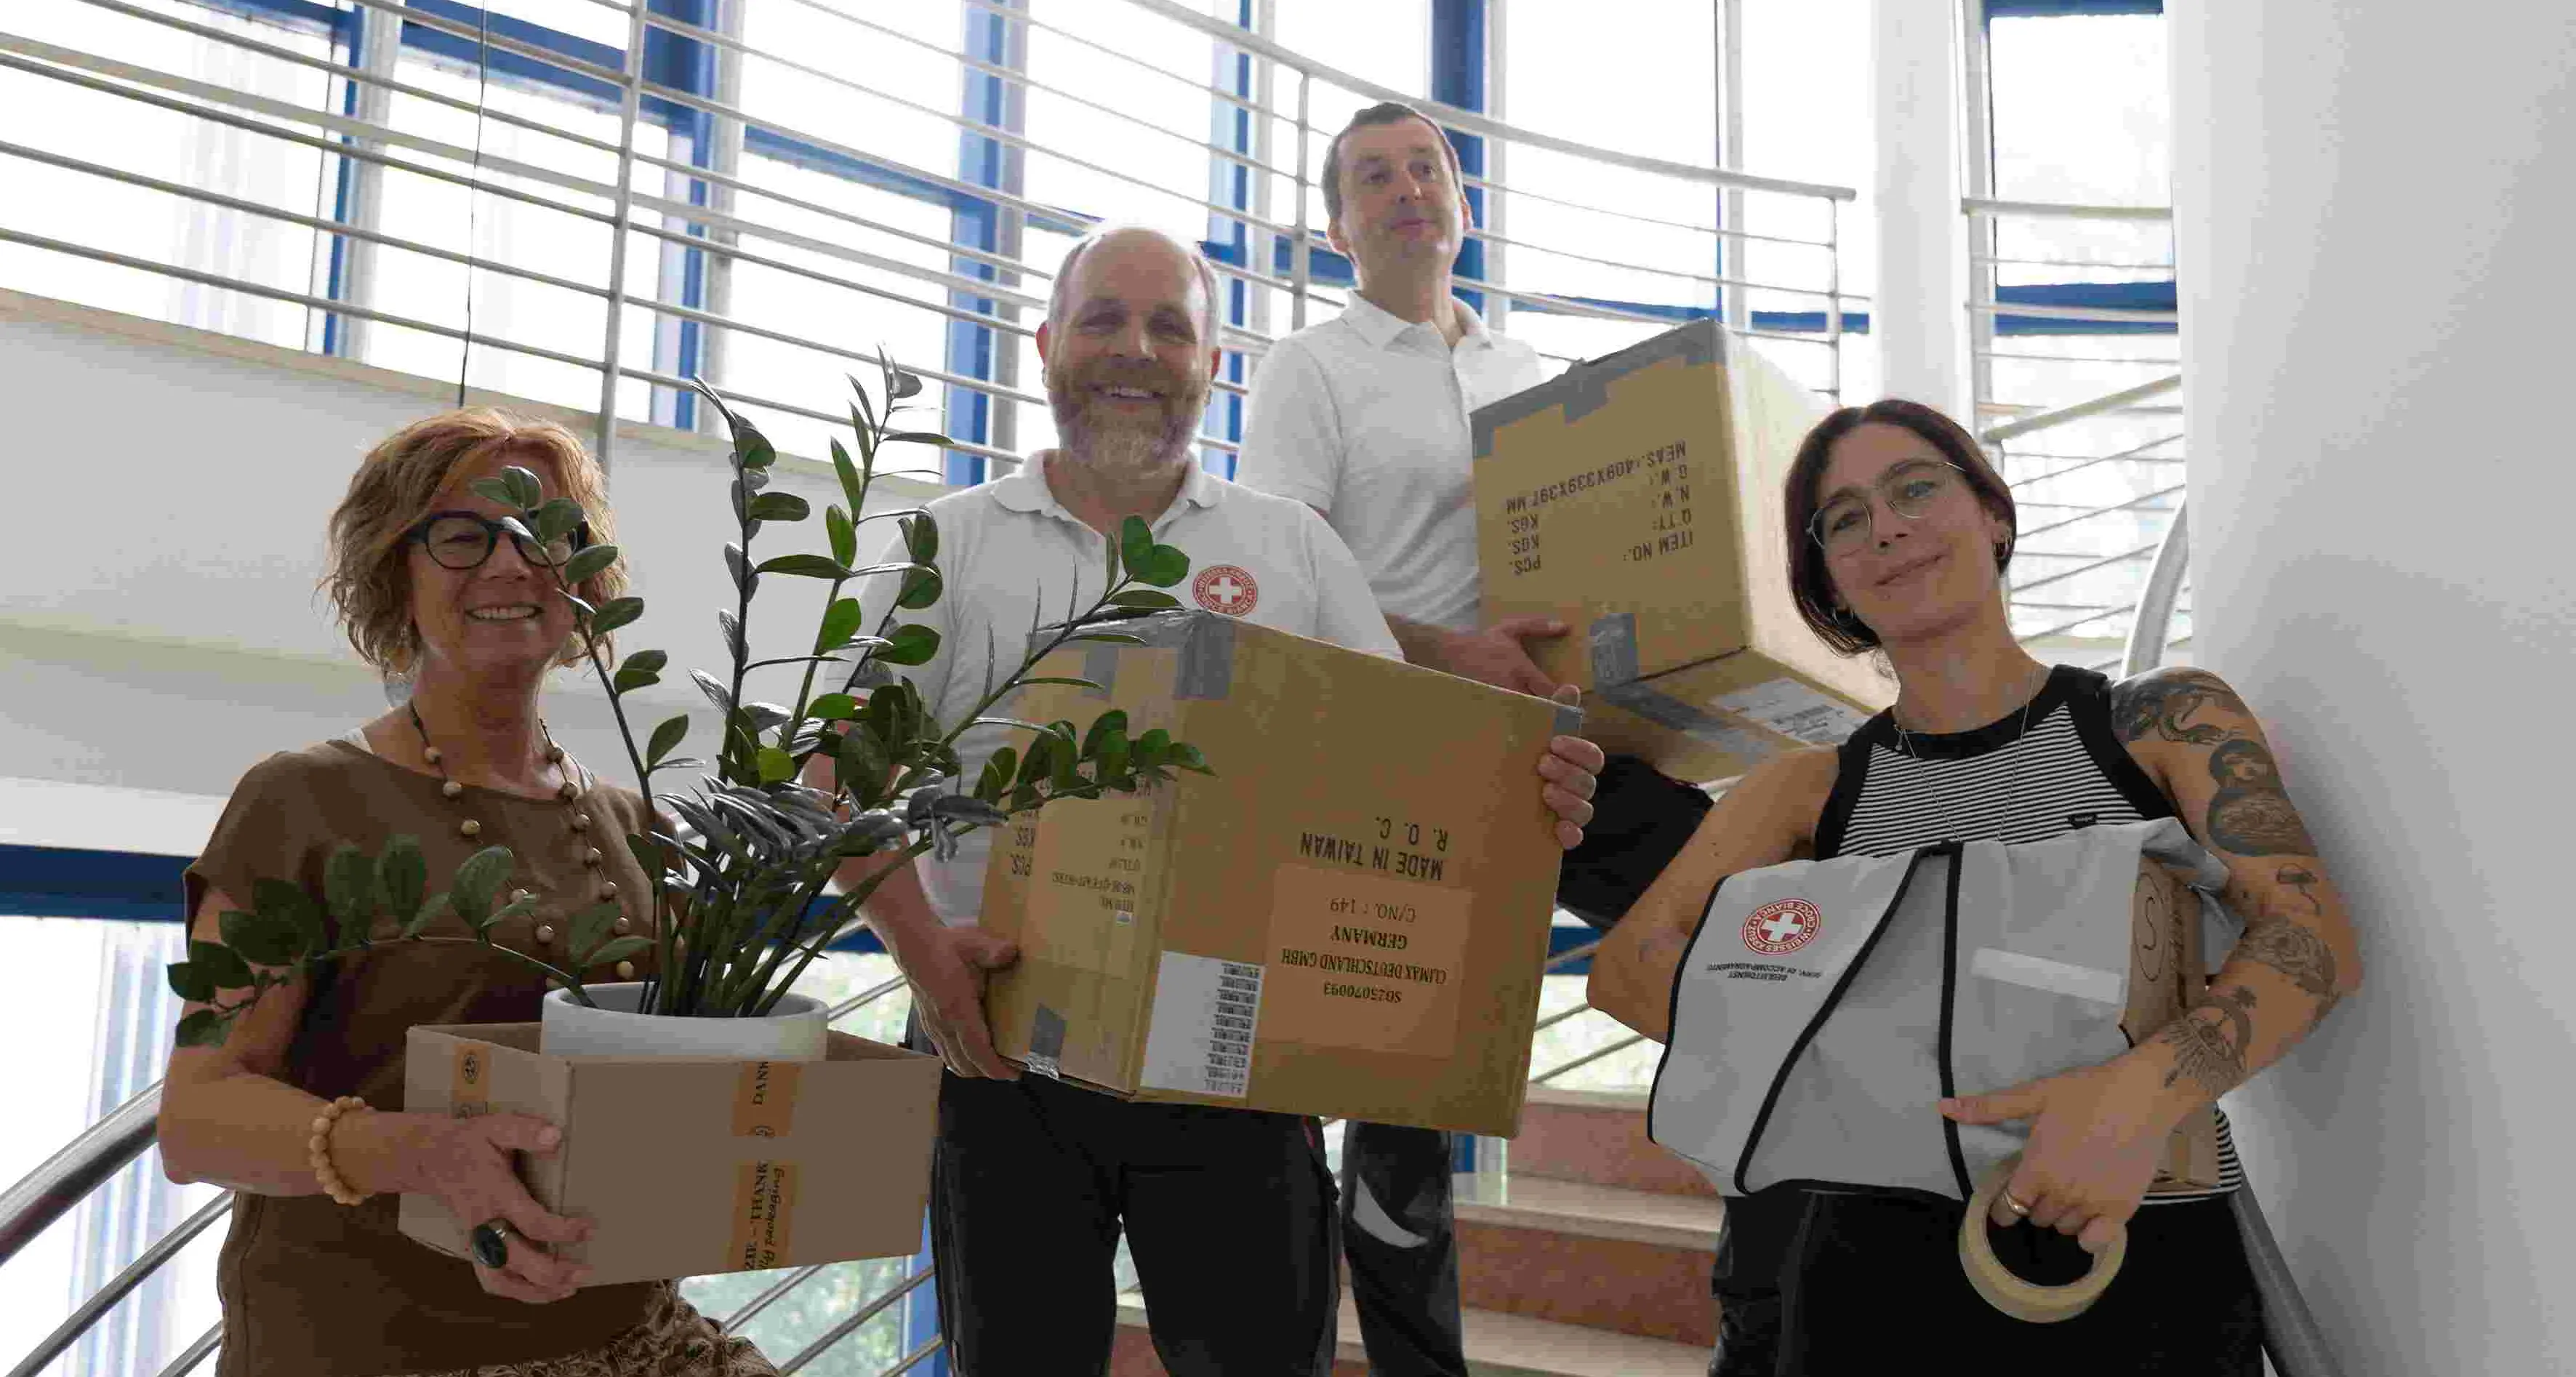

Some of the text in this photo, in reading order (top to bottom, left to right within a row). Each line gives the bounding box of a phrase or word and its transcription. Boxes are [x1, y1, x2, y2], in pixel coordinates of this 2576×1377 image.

[1507, 514, 1539, 534] KGS.
[1507, 534, 1539, 555] KGS.
[1658, 531, 1693, 555] ITEM
[1509, 555, 1541, 576] PCS.
[1300, 832, 1443, 880] MADE IN TAIWAN
[1330, 897, 1356, 912] 149
[1331, 925, 1408, 949] GERMANY
[1281, 949, 1447, 984] CLIMAX DEUTSCHLAND GMBH
[750, 1160, 769, 1224] THANK
